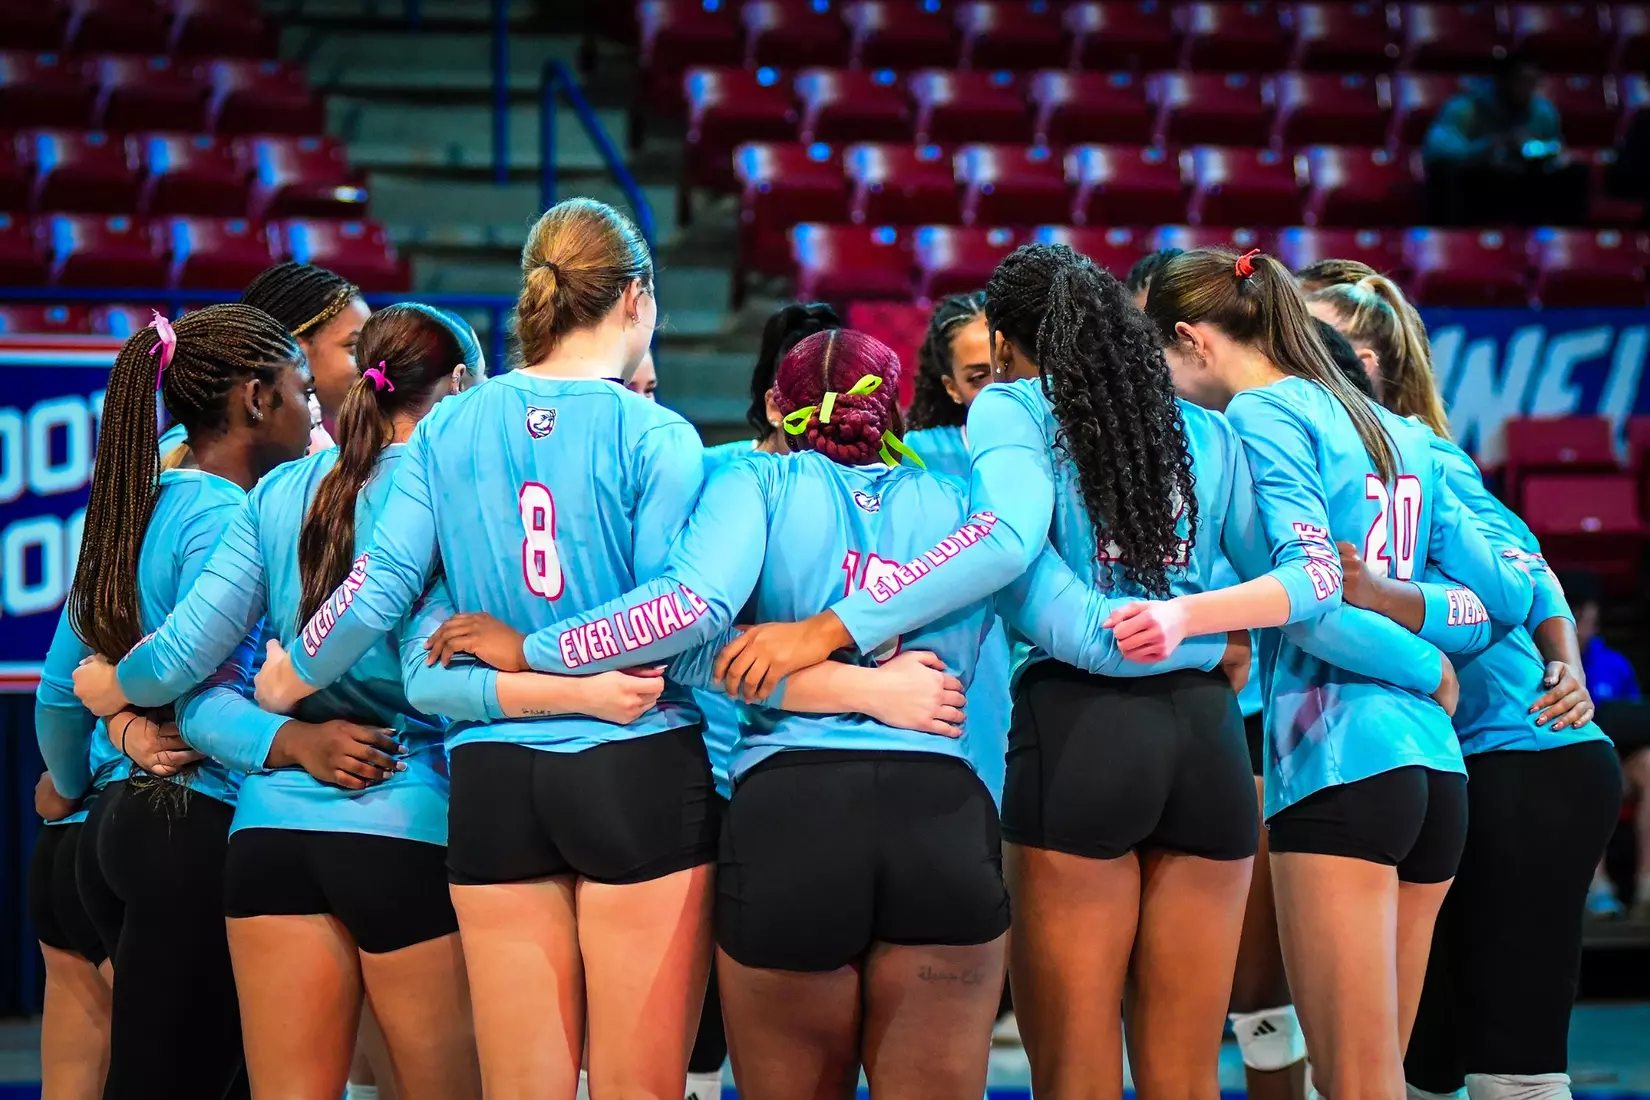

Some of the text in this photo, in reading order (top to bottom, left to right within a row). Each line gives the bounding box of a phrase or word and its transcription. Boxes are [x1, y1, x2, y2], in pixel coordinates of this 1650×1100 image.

[519, 481, 564, 602] 8
[1364, 474, 1422, 581] 20
[867, 557, 931, 604] EVER
[559, 618, 620, 669] EVER
[614, 591, 697, 651] LOYAL
